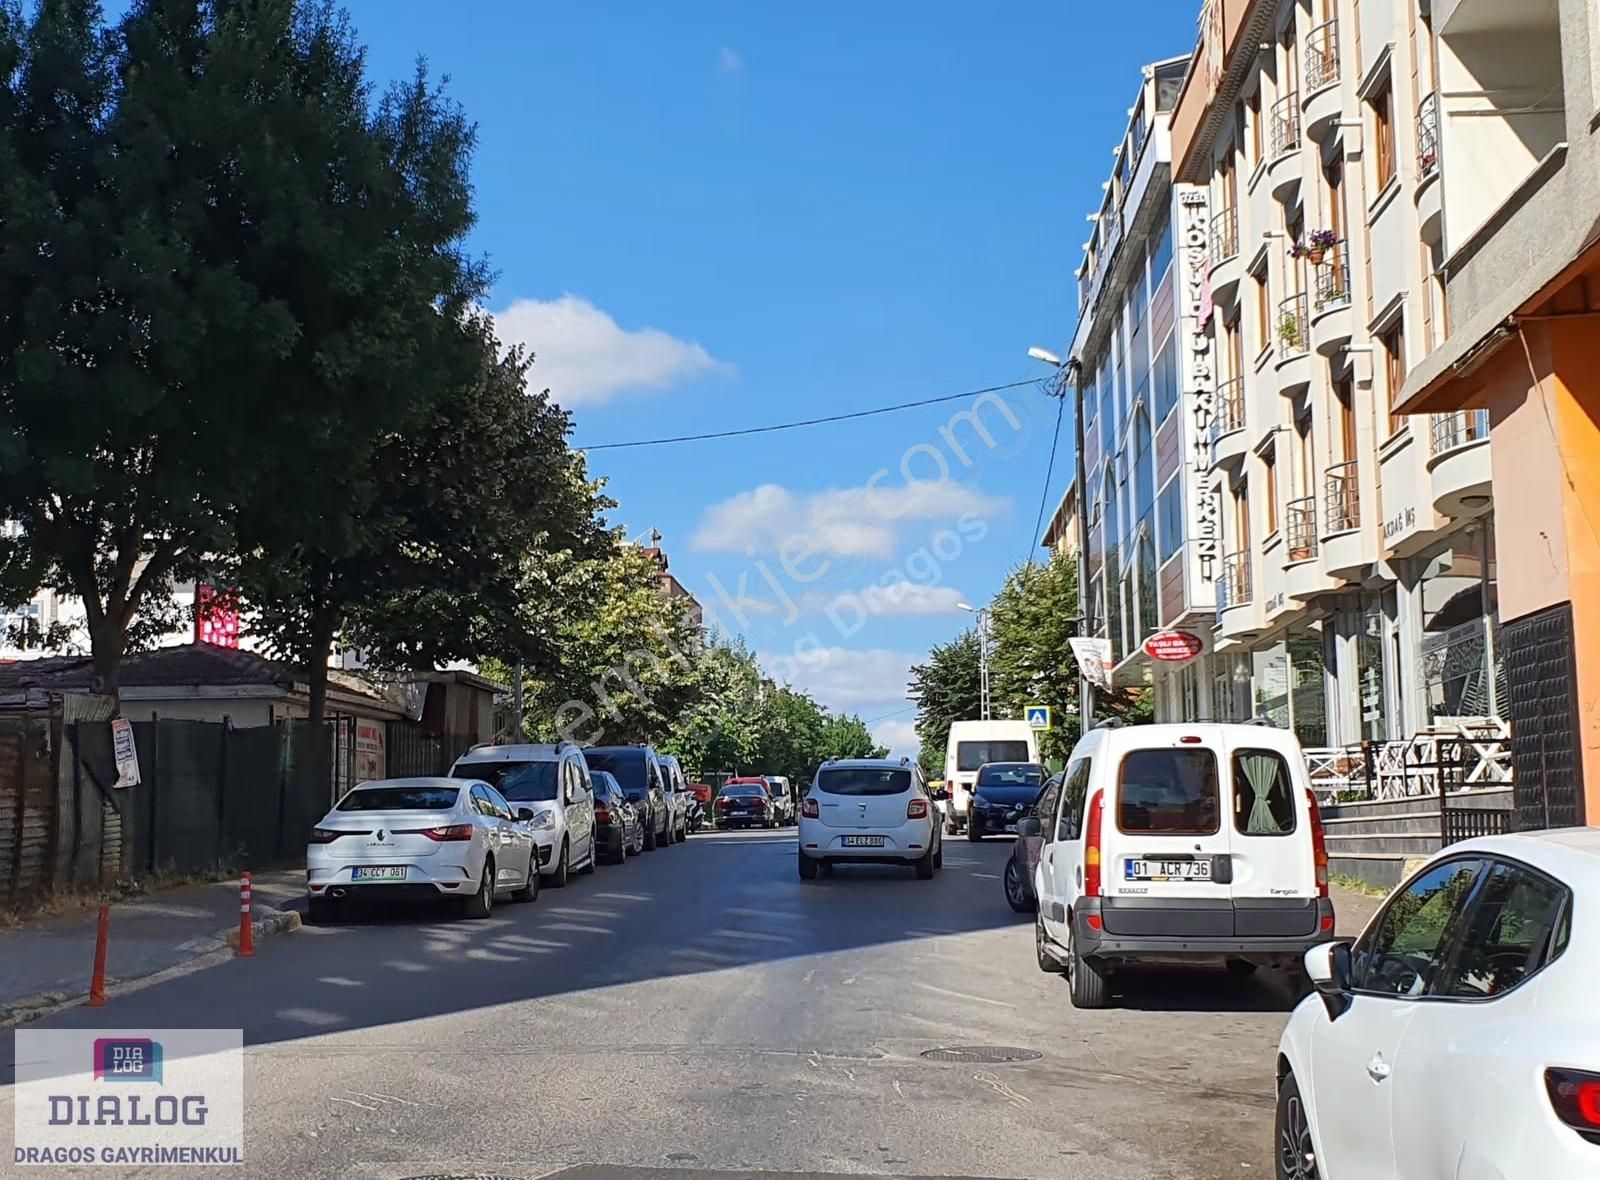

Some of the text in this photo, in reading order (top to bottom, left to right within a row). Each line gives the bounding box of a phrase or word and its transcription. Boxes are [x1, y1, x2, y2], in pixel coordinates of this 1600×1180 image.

[1133, 861, 1209, 876] 01 ACR 736
